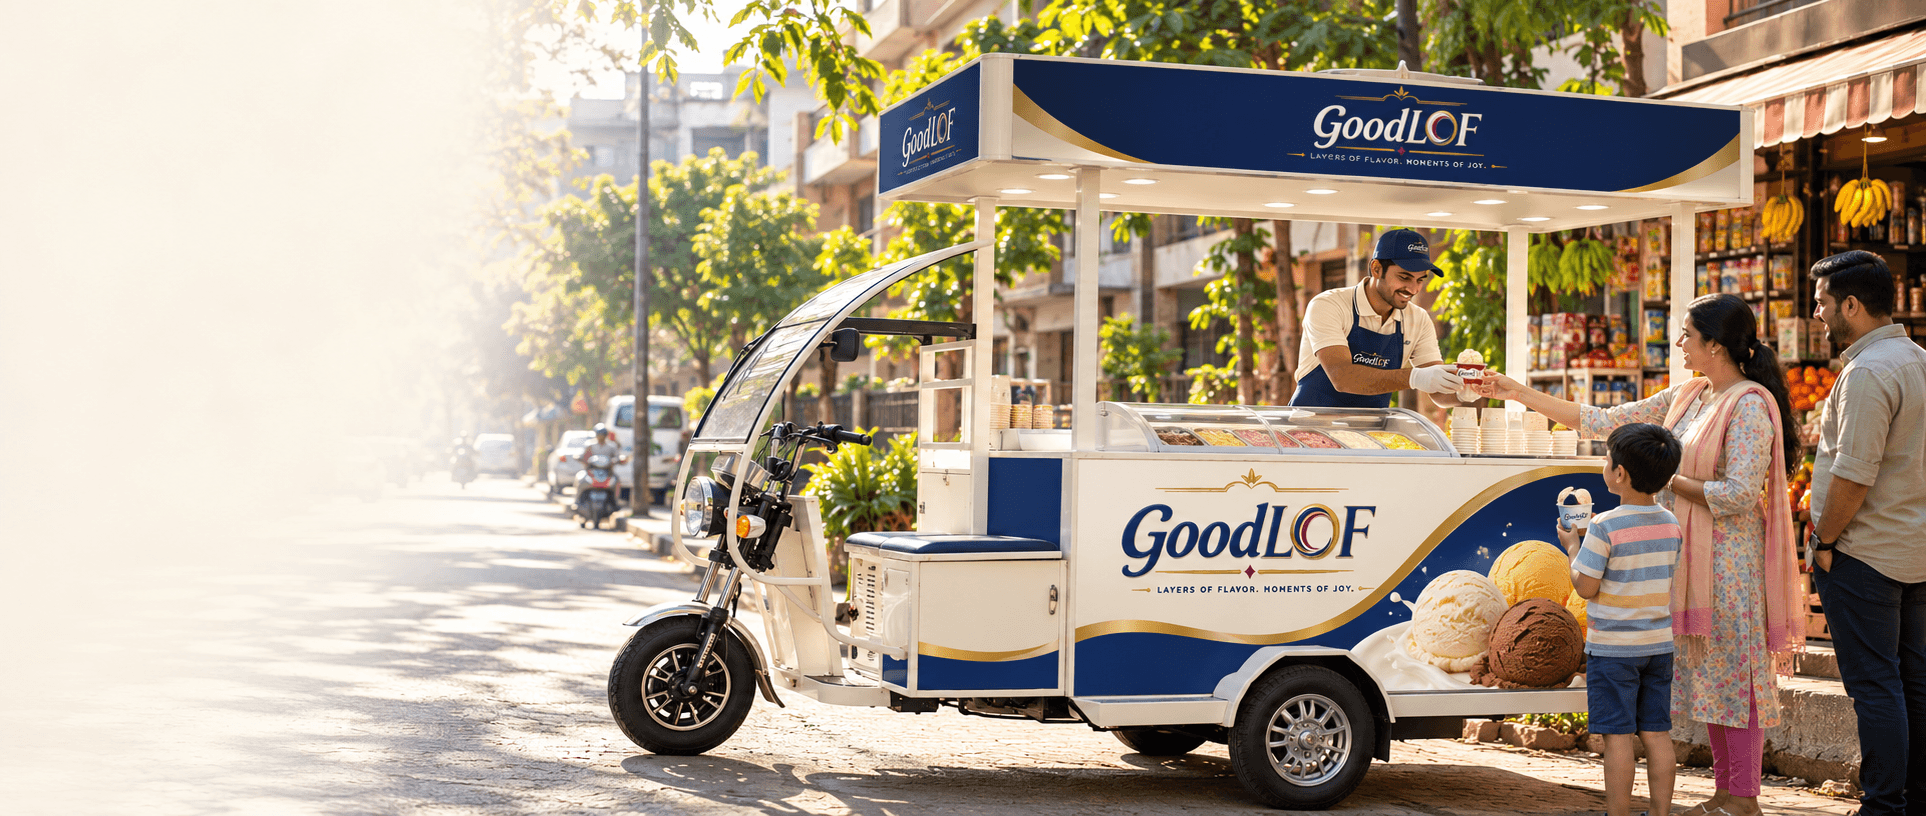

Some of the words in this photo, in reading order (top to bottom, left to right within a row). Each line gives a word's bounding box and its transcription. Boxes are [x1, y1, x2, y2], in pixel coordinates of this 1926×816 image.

[902, 107, 956, 168] GoodLOF
[1313, 104, 1483, 149] GoodLOF
[1121, 502, 1377, 578] GoodLOF
[1157, 586, 1196, 594] LAYERS
[1199, 585, 1213, 594] OF
[1217, 585, 1259, 594] FLAVOR.
[1316, 585, 1329, 593] OF
[1332, 585, 1355, 593] JOY.
